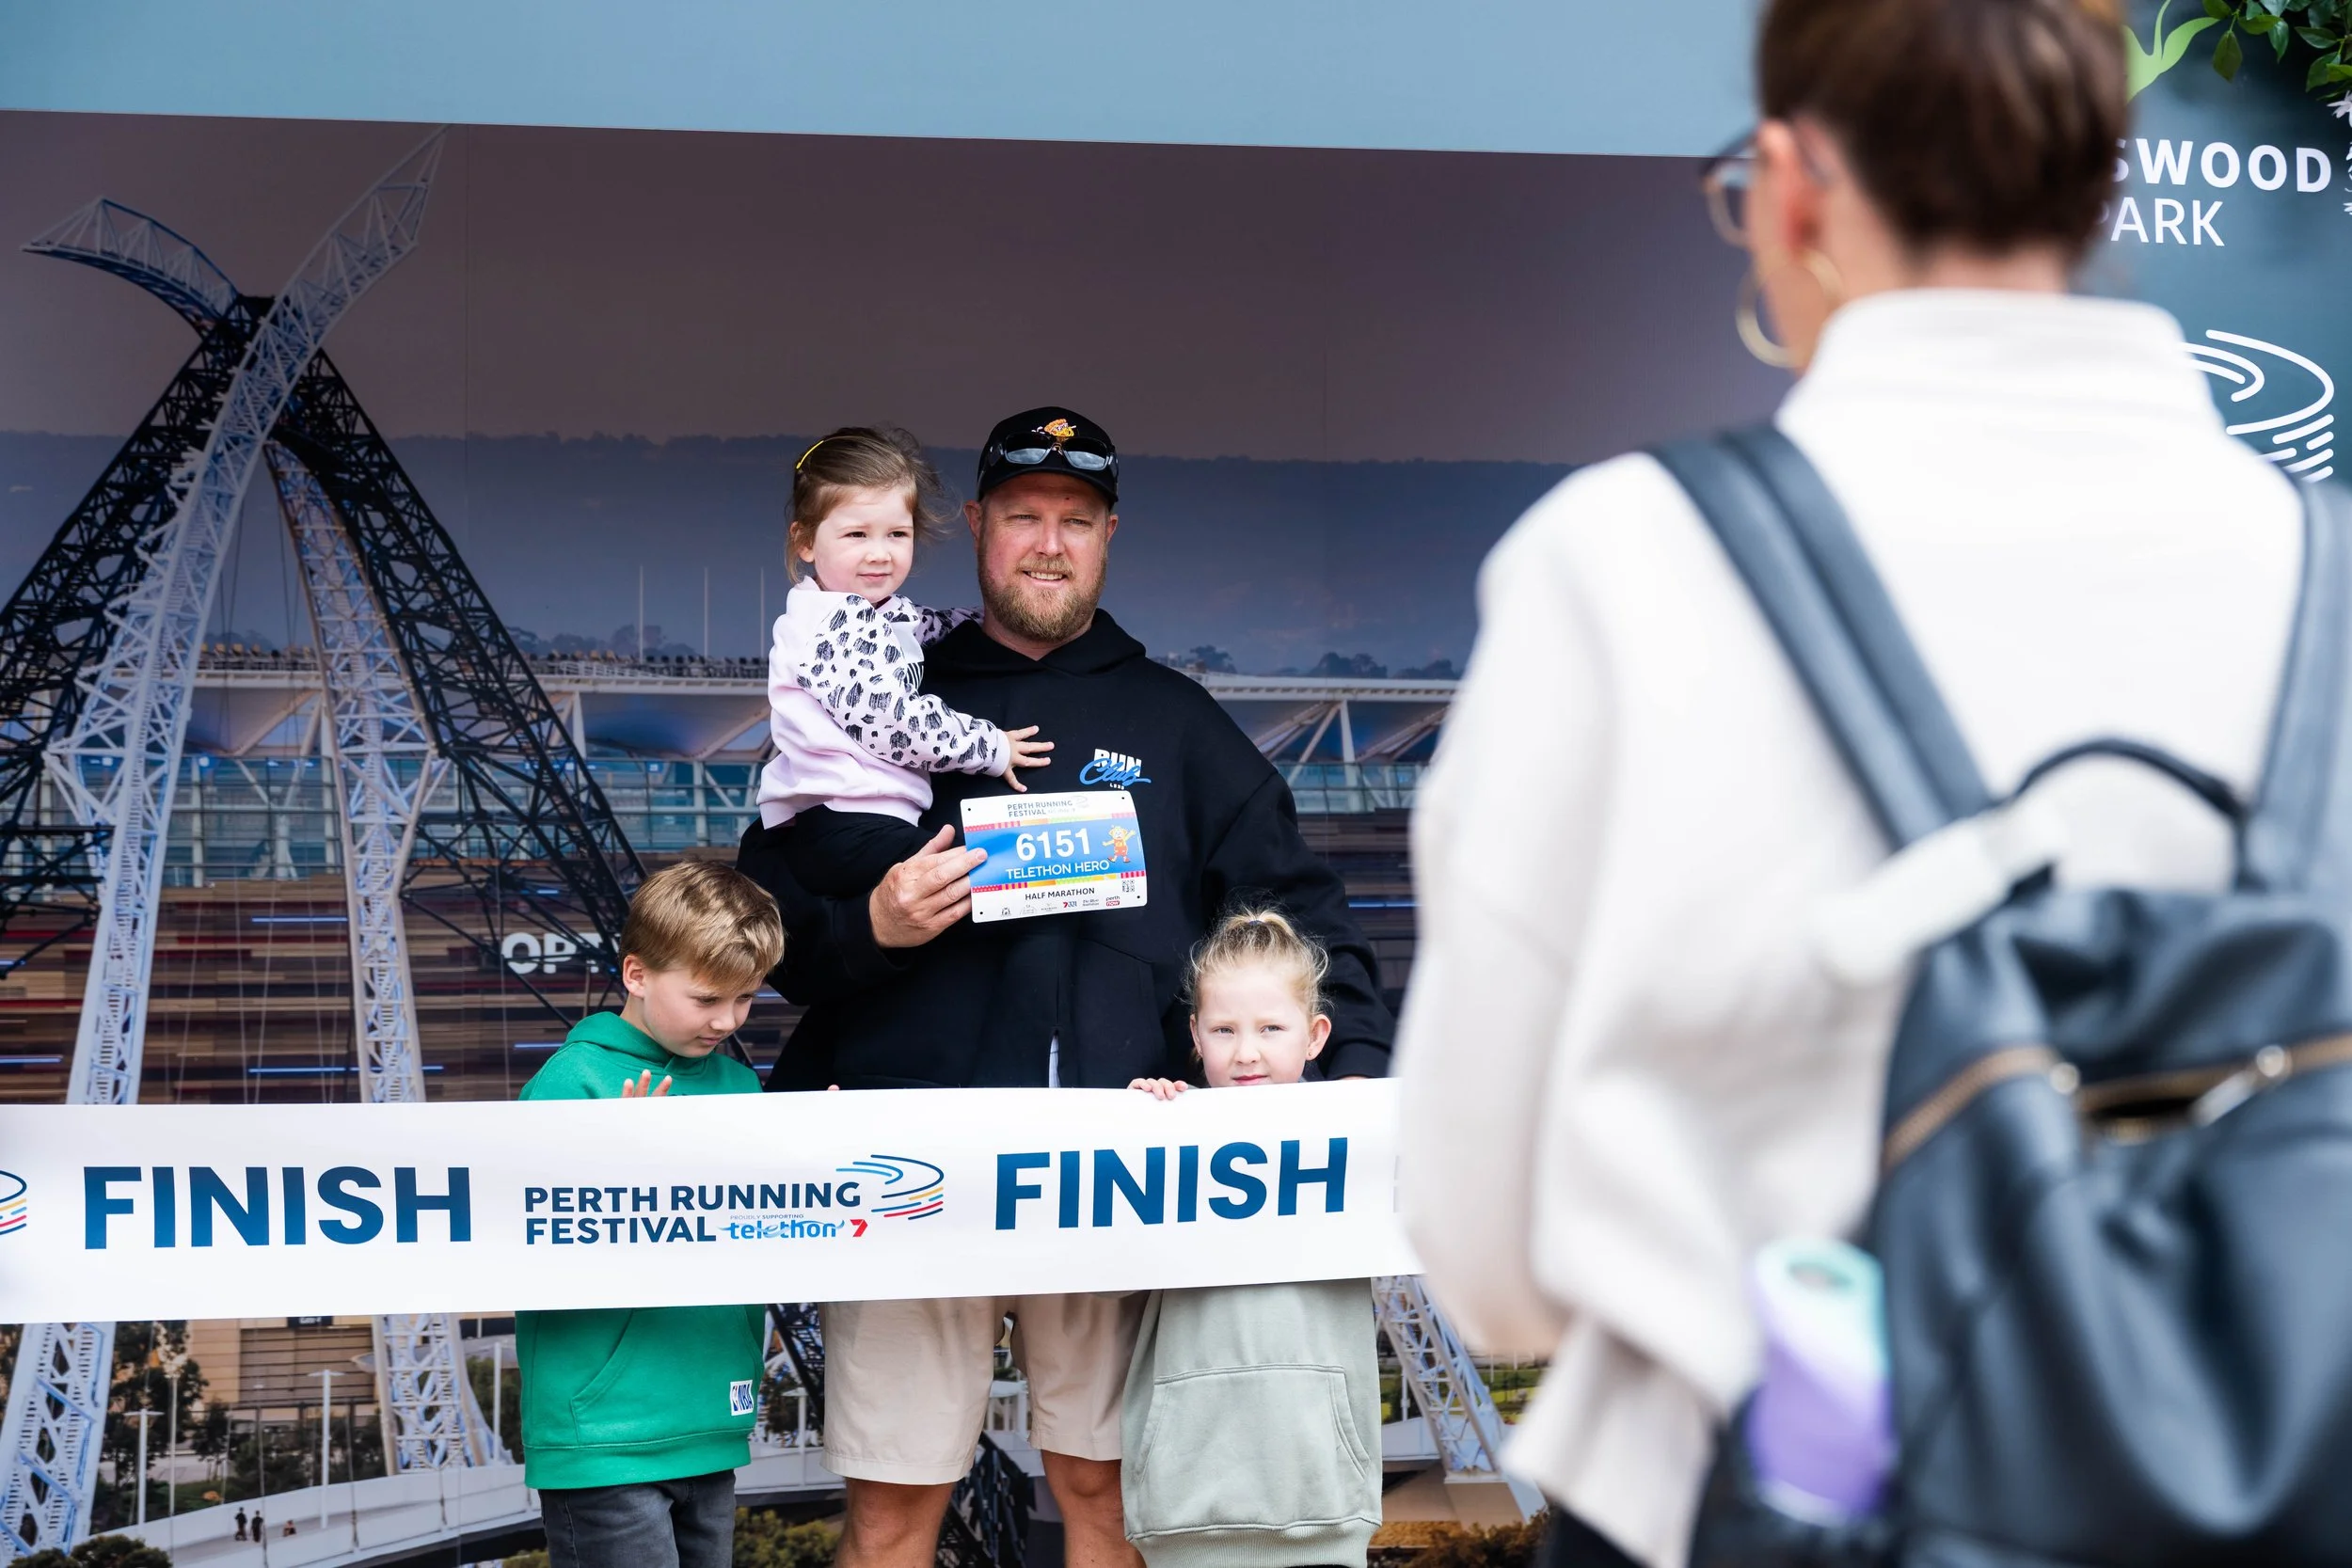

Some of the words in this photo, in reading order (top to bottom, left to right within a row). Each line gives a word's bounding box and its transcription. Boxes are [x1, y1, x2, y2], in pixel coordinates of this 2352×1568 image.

[2098, 197, 2225, 246] ARK
[1079, 757, 1152, 786] Club
[1094, 749, 1142, 777] RUN
[1007, 802, 1034, 811] PERTH
[1035, 800, 1073, 809] RUNNING
[1009, 809, 1047, 817] FESTIVAL
[1016, 828, 1090, 862] 6151
[1006, 863, 1072, 879] TELETHON
[1074, 860, 1110, 873] HERO
[1025, 892, 1046, 900] HALF
[1048, 887, 1095, 898] MARATHON
[525, 1186, 658, 1212] PERTH
[670, 1181, 861, 1212] RUNNING
[995, 1137, 1348, 1230] FINISH
[84, 1165, 472, 1249] FINISH
[526, 1215, 717, 1244] FESTIVAL
[728, 1219, 837, 1240] telethon
